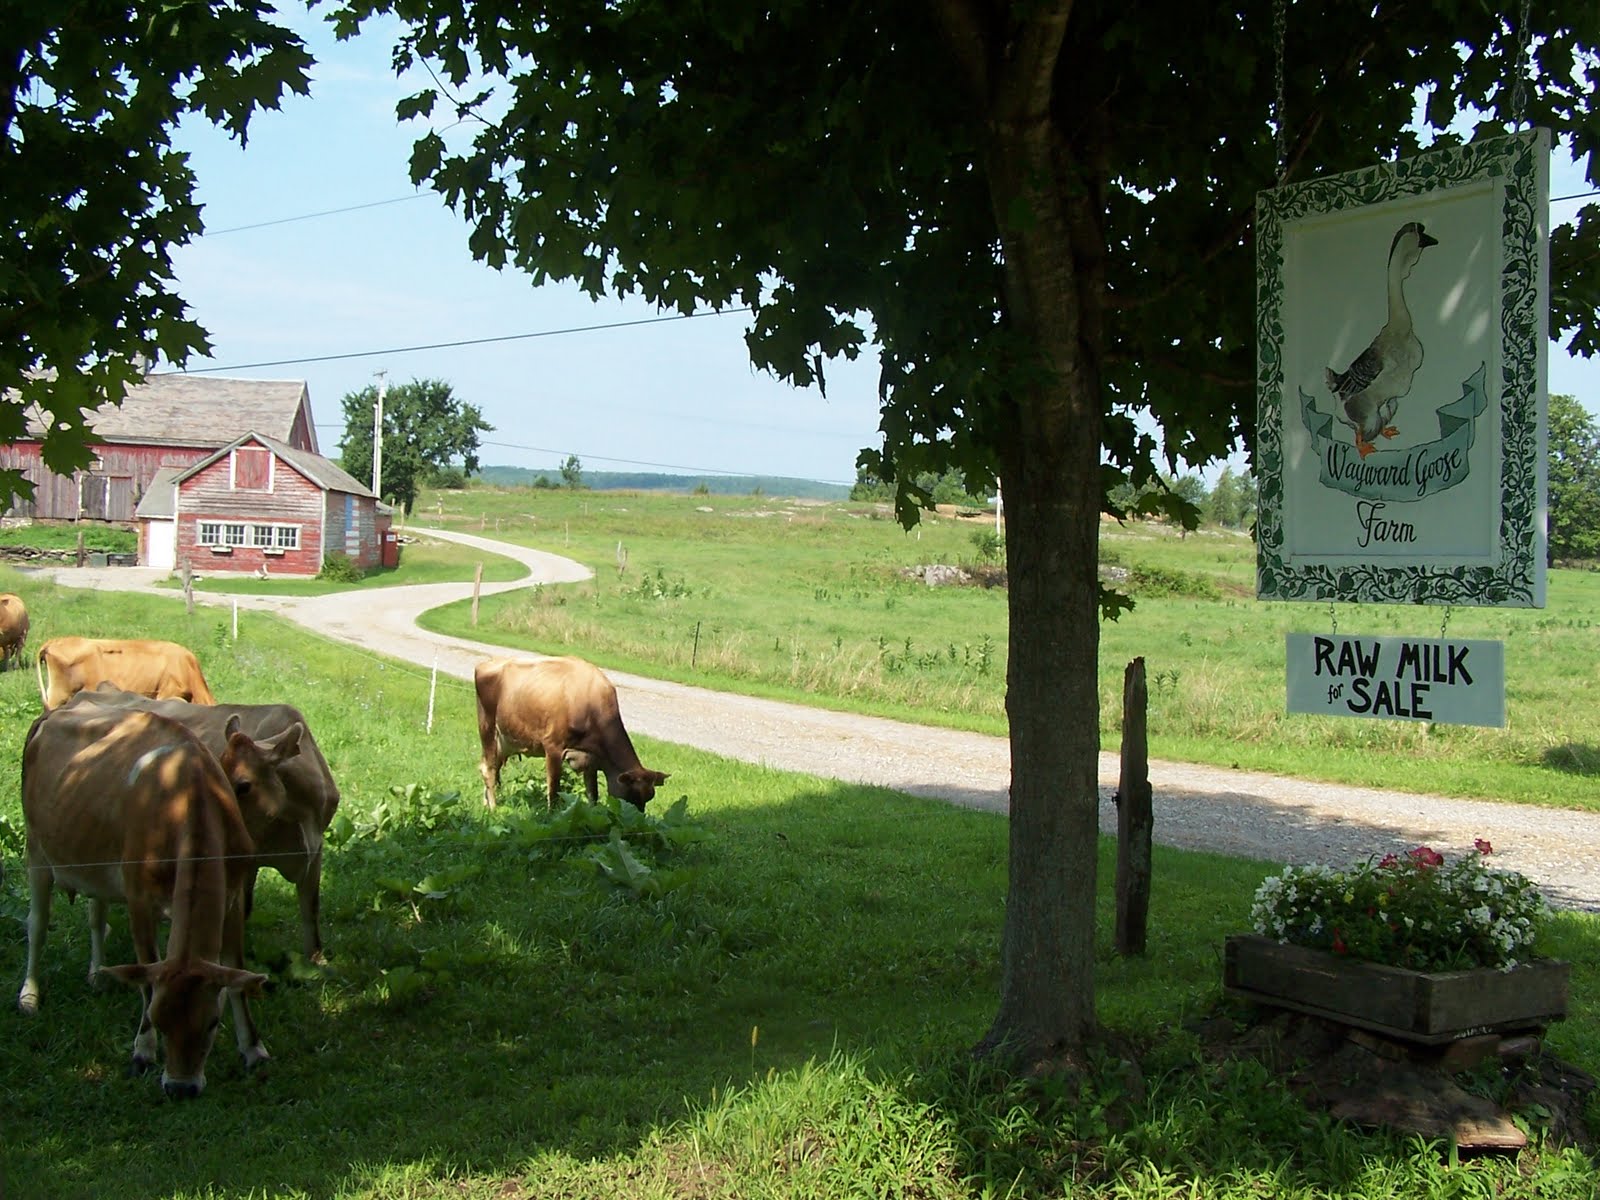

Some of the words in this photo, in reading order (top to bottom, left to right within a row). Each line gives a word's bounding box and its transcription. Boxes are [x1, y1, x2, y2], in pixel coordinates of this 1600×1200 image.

[1327, 442, 1411, 491] Wayward
[1415, 448, 1462, 496] Goose
[1357, 501, 1417, 548] Farm
[1314, 637, 1381, 678] RAW
[1397, 643, 1473, 686] MILK
[1327, 683, 1344, 704] for
[1346, 678, 1433, 720] SALE
